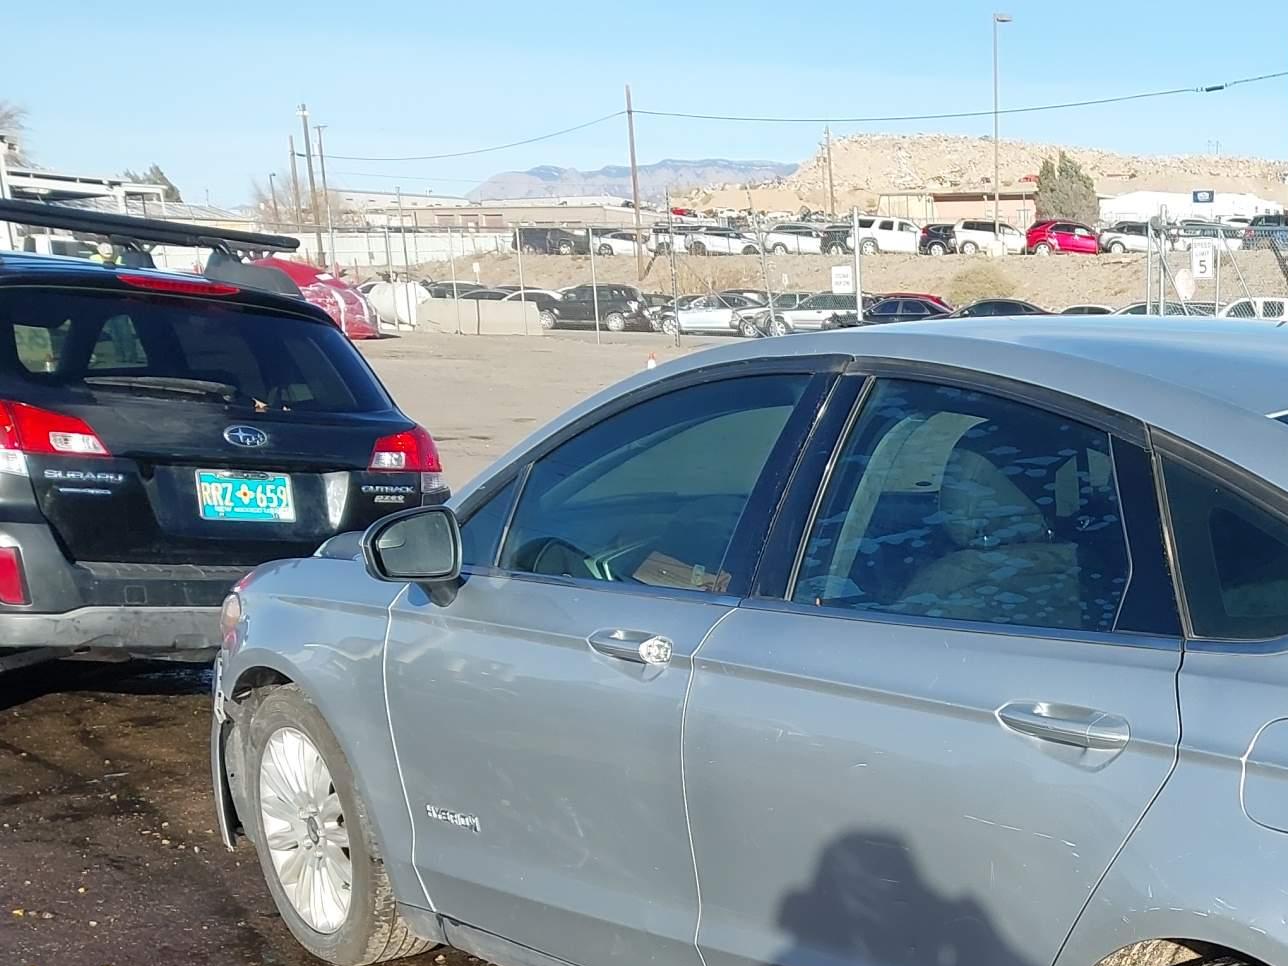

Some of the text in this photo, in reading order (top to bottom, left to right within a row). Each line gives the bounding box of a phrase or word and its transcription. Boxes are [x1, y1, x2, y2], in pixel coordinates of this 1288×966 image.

[1199, 259, 1207, 274] 5
[43, 468, 124, 484] SUBARU
[256, 485, 287, 509] 659
